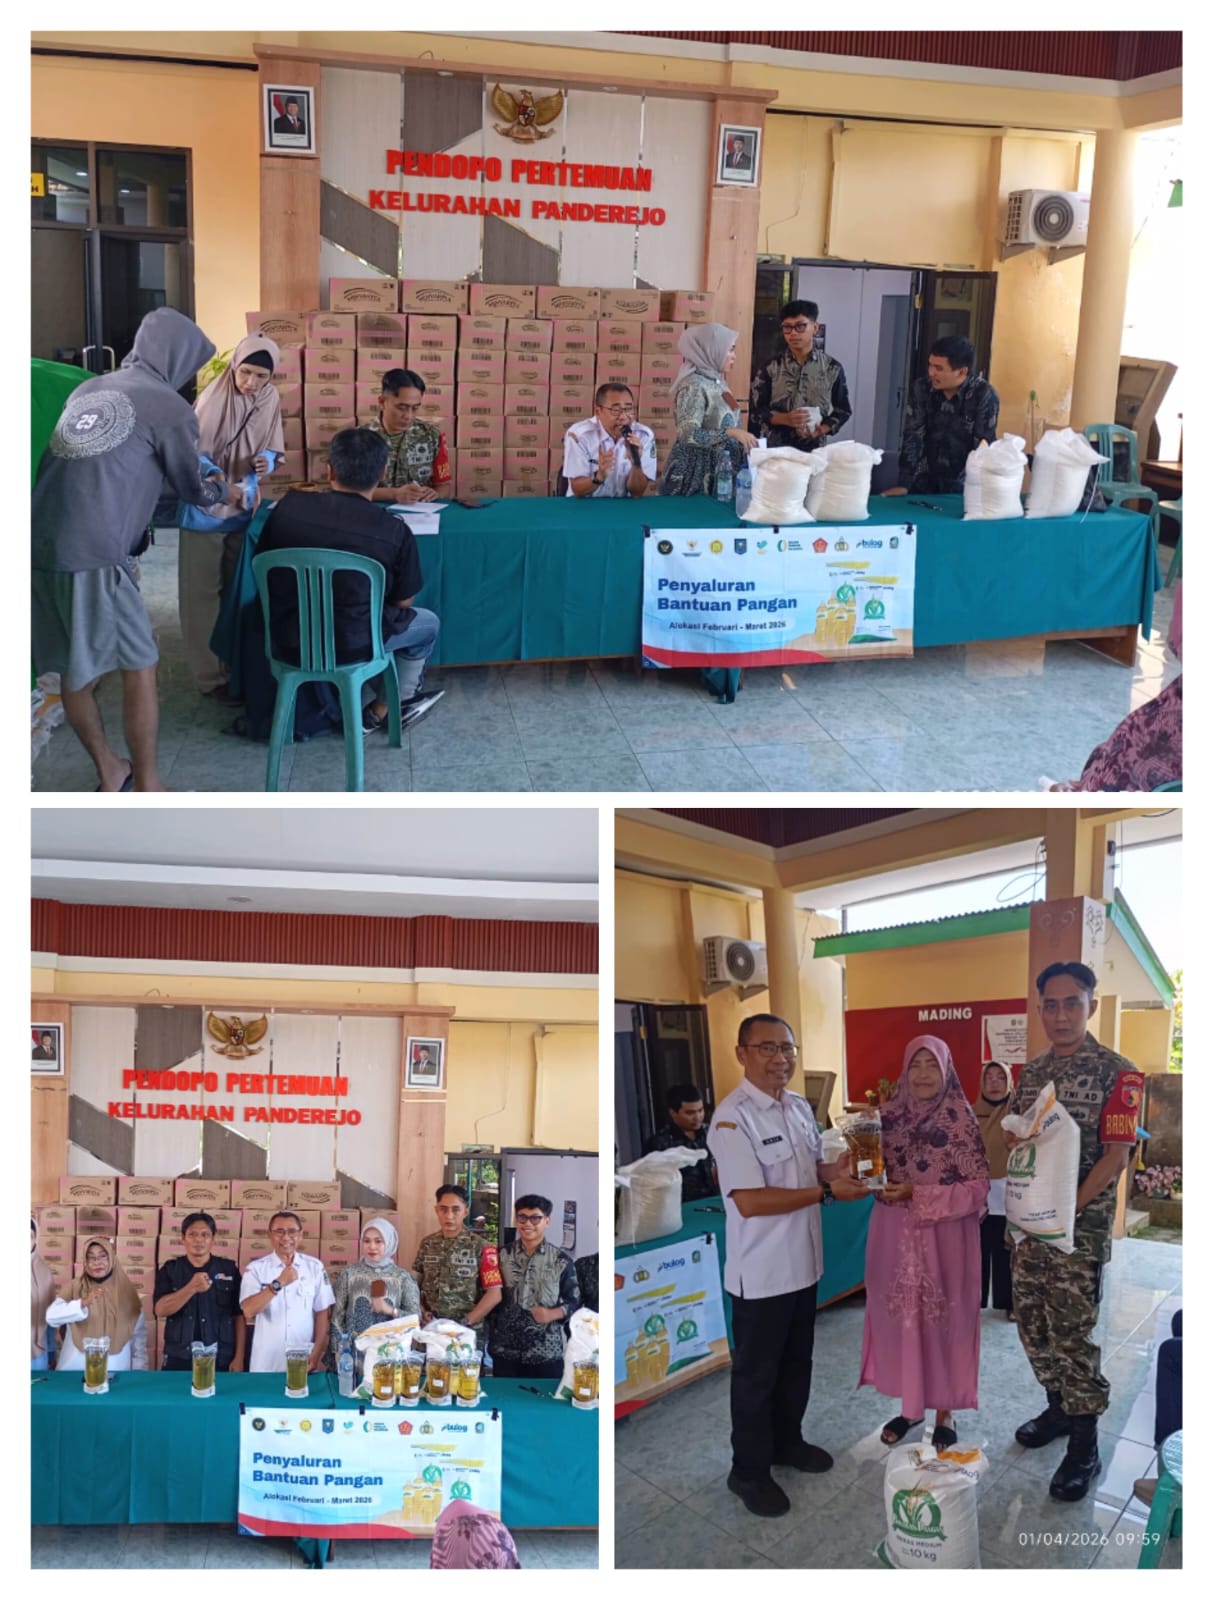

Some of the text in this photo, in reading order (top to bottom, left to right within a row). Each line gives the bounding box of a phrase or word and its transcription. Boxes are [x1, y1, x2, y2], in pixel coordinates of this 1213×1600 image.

[386, 149, 652, 192] PENDOPO PERTEMUAN
[368, 189, 666, 226] KELURAHAN PANDEREJO
[75, 414, 98, 430] 29
[657, 578, 756, 593] Penyaluran
[657, 597, 797, 613] Bantuan Pangan
[669, 621, 701, 630] Alokasi
[703, 622, 738, 631] Februari
[769, 620, 787, 629] 2026
[918, 1007, 973, 1022] MADING
[122, 1068, 348, 1097] PENDOPO PERTEMUAN
[1063, 1090, 1098, 1101] TNI AD
[108, 1102, 362, 1126] KELURAHAN PANDEREJO
[253, 1452, 342, 1469] Penyaluran
[252, 1470, 383, 1488] Bantuan Pangan
[923, 1549, 936, 1562] kg
